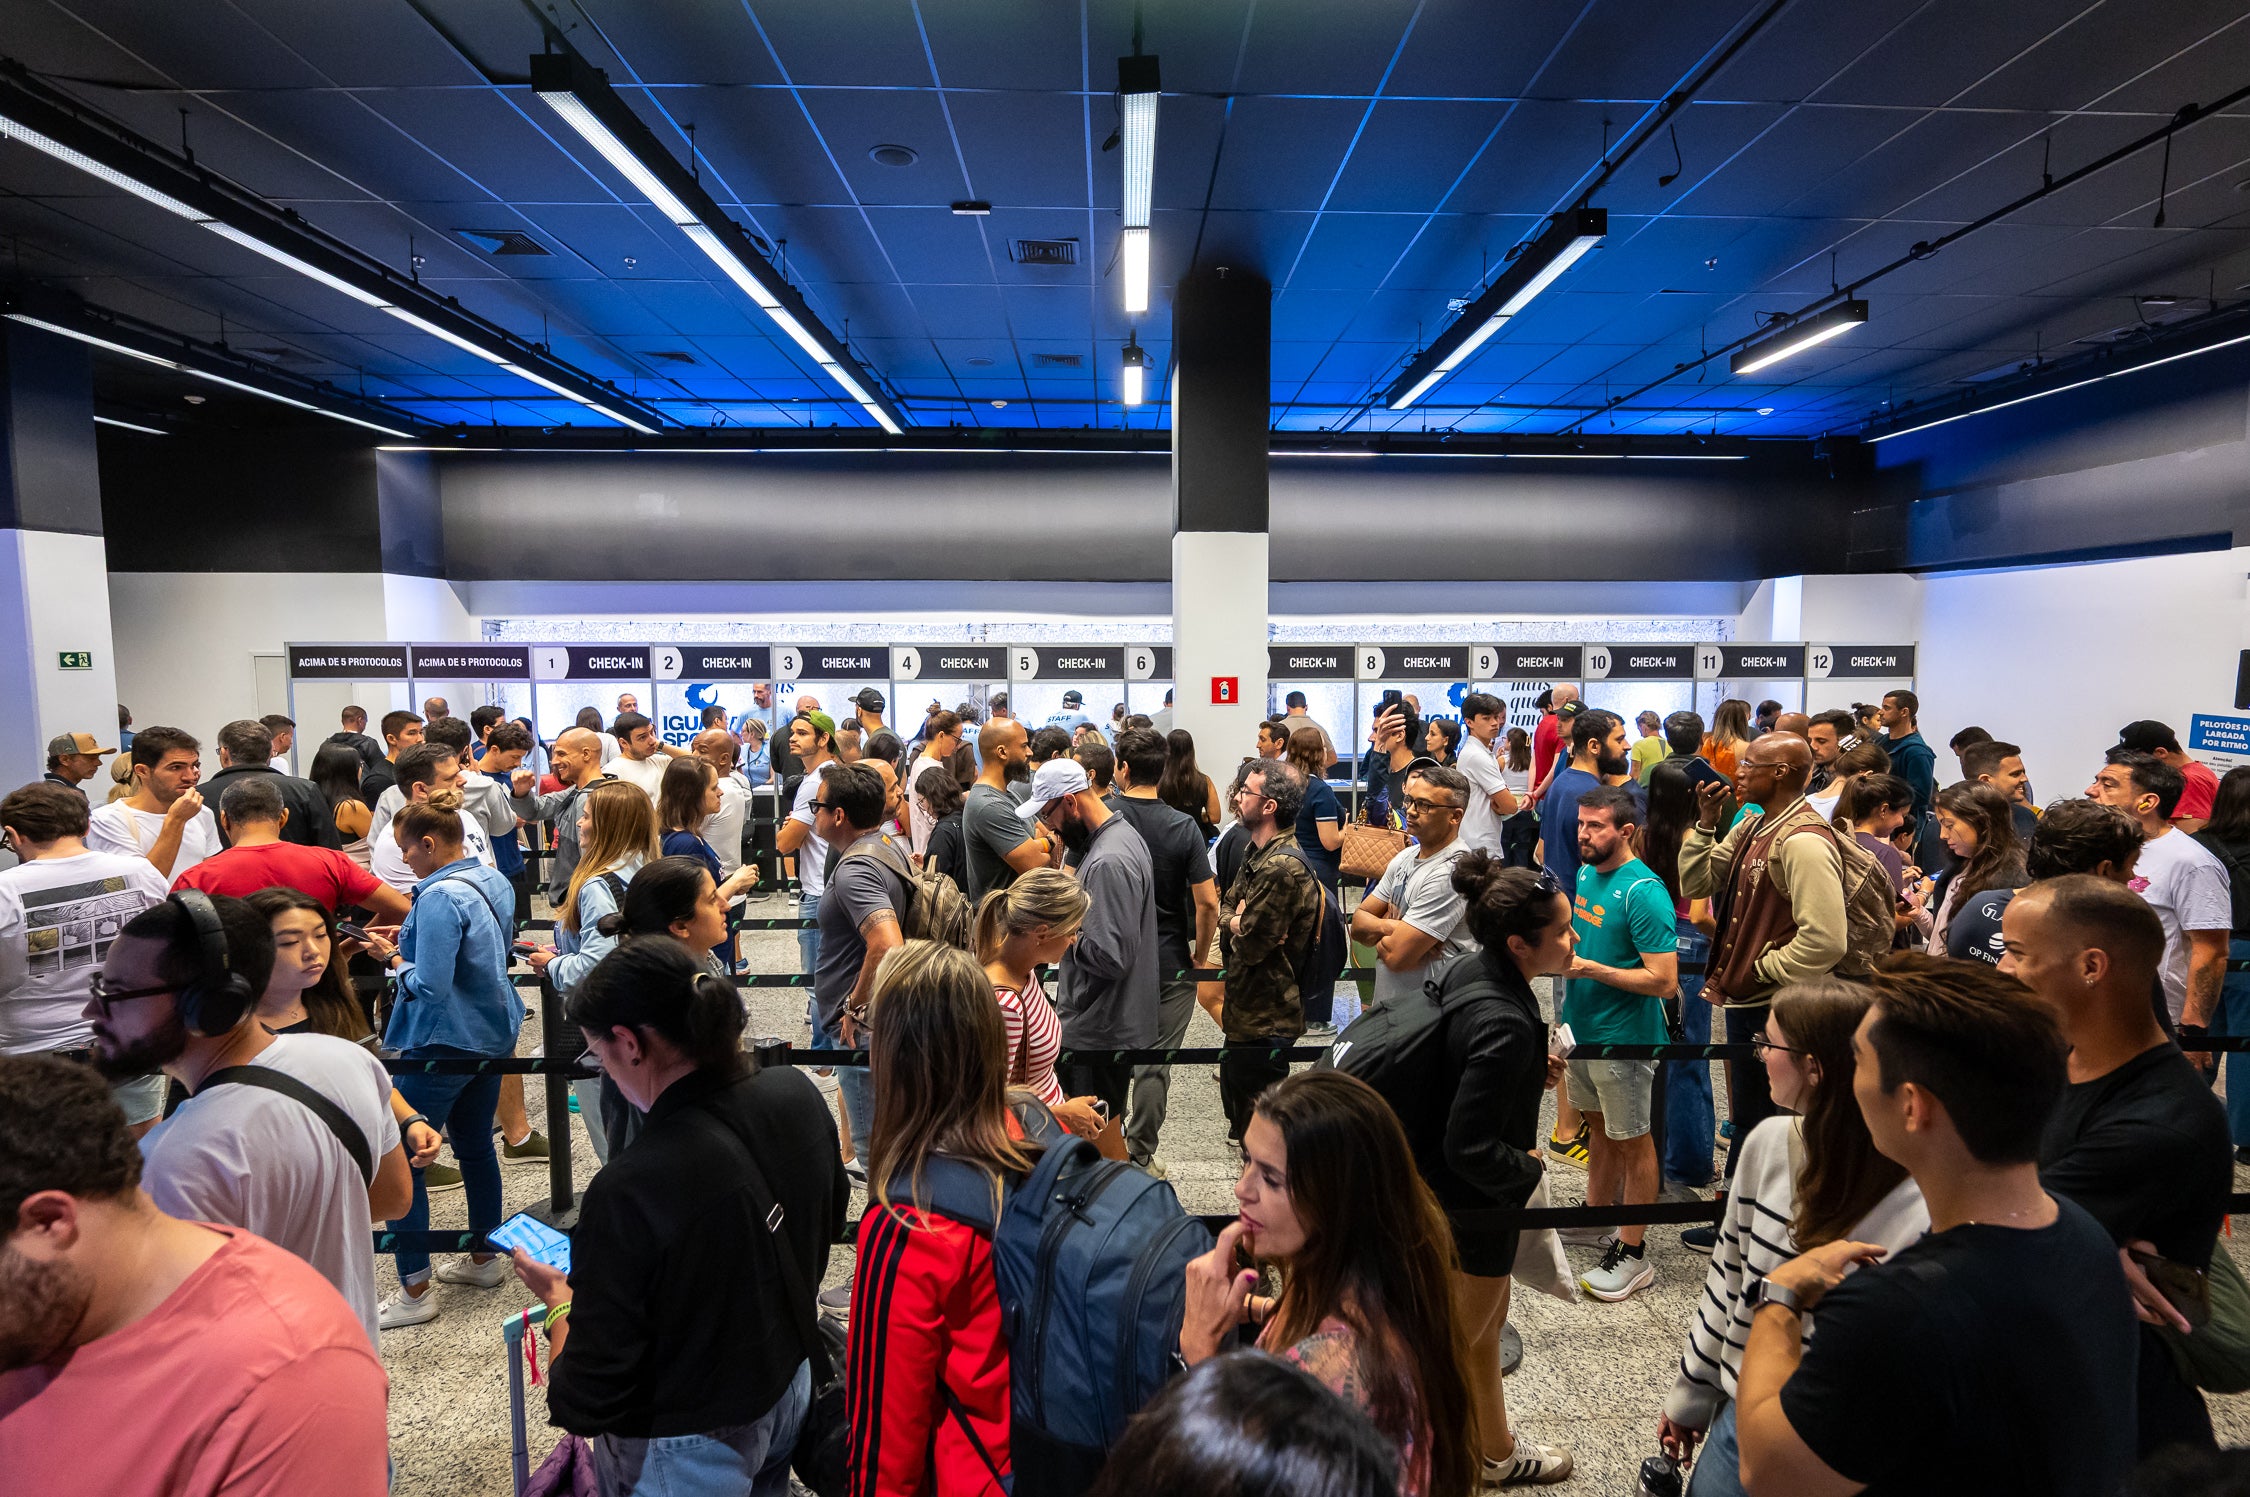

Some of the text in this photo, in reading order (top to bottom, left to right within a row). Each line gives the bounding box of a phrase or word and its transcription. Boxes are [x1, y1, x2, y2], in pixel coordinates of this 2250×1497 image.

[298, 657, 403, 668] ACIMA DE 5 PROTOCOLOS
[418, 657, 523, 668] ACIMA DE 5 PROTOCOLOS
[548, 656, 643, 669] 1 CHECK-IN
[664, 655, 752, 670] 2 CHECK-IN
[783, 656, 871, 671] 3 CHECK-IN
[902, 656, 989, 670] 4 CHECK-IN
[1020, 656, 1106, 671] 5 CHECK-IN
[1136, 655, 1146, 671] 6
[1289, 657, 1337, 669] CHECK-IN
[1366, 655, 1451, 670] 8 CHECK-IN
[1480, 655, 1564, 670] 9 CHECK-IN
[1590, 655, 1677, 670] 10 CHECK-IN
[1702, 655, 1787, 670] 11 CHECK-IN
[1812, 655, 1897, 669] 12 CHECK-IN
[1047, 715, 1072, 723] STAFF
[2205, 730, 2246, 741] LARGADA
[2242, 724, 2250, 733] D
[2202, 739, 2249, 750] POR RITMO
